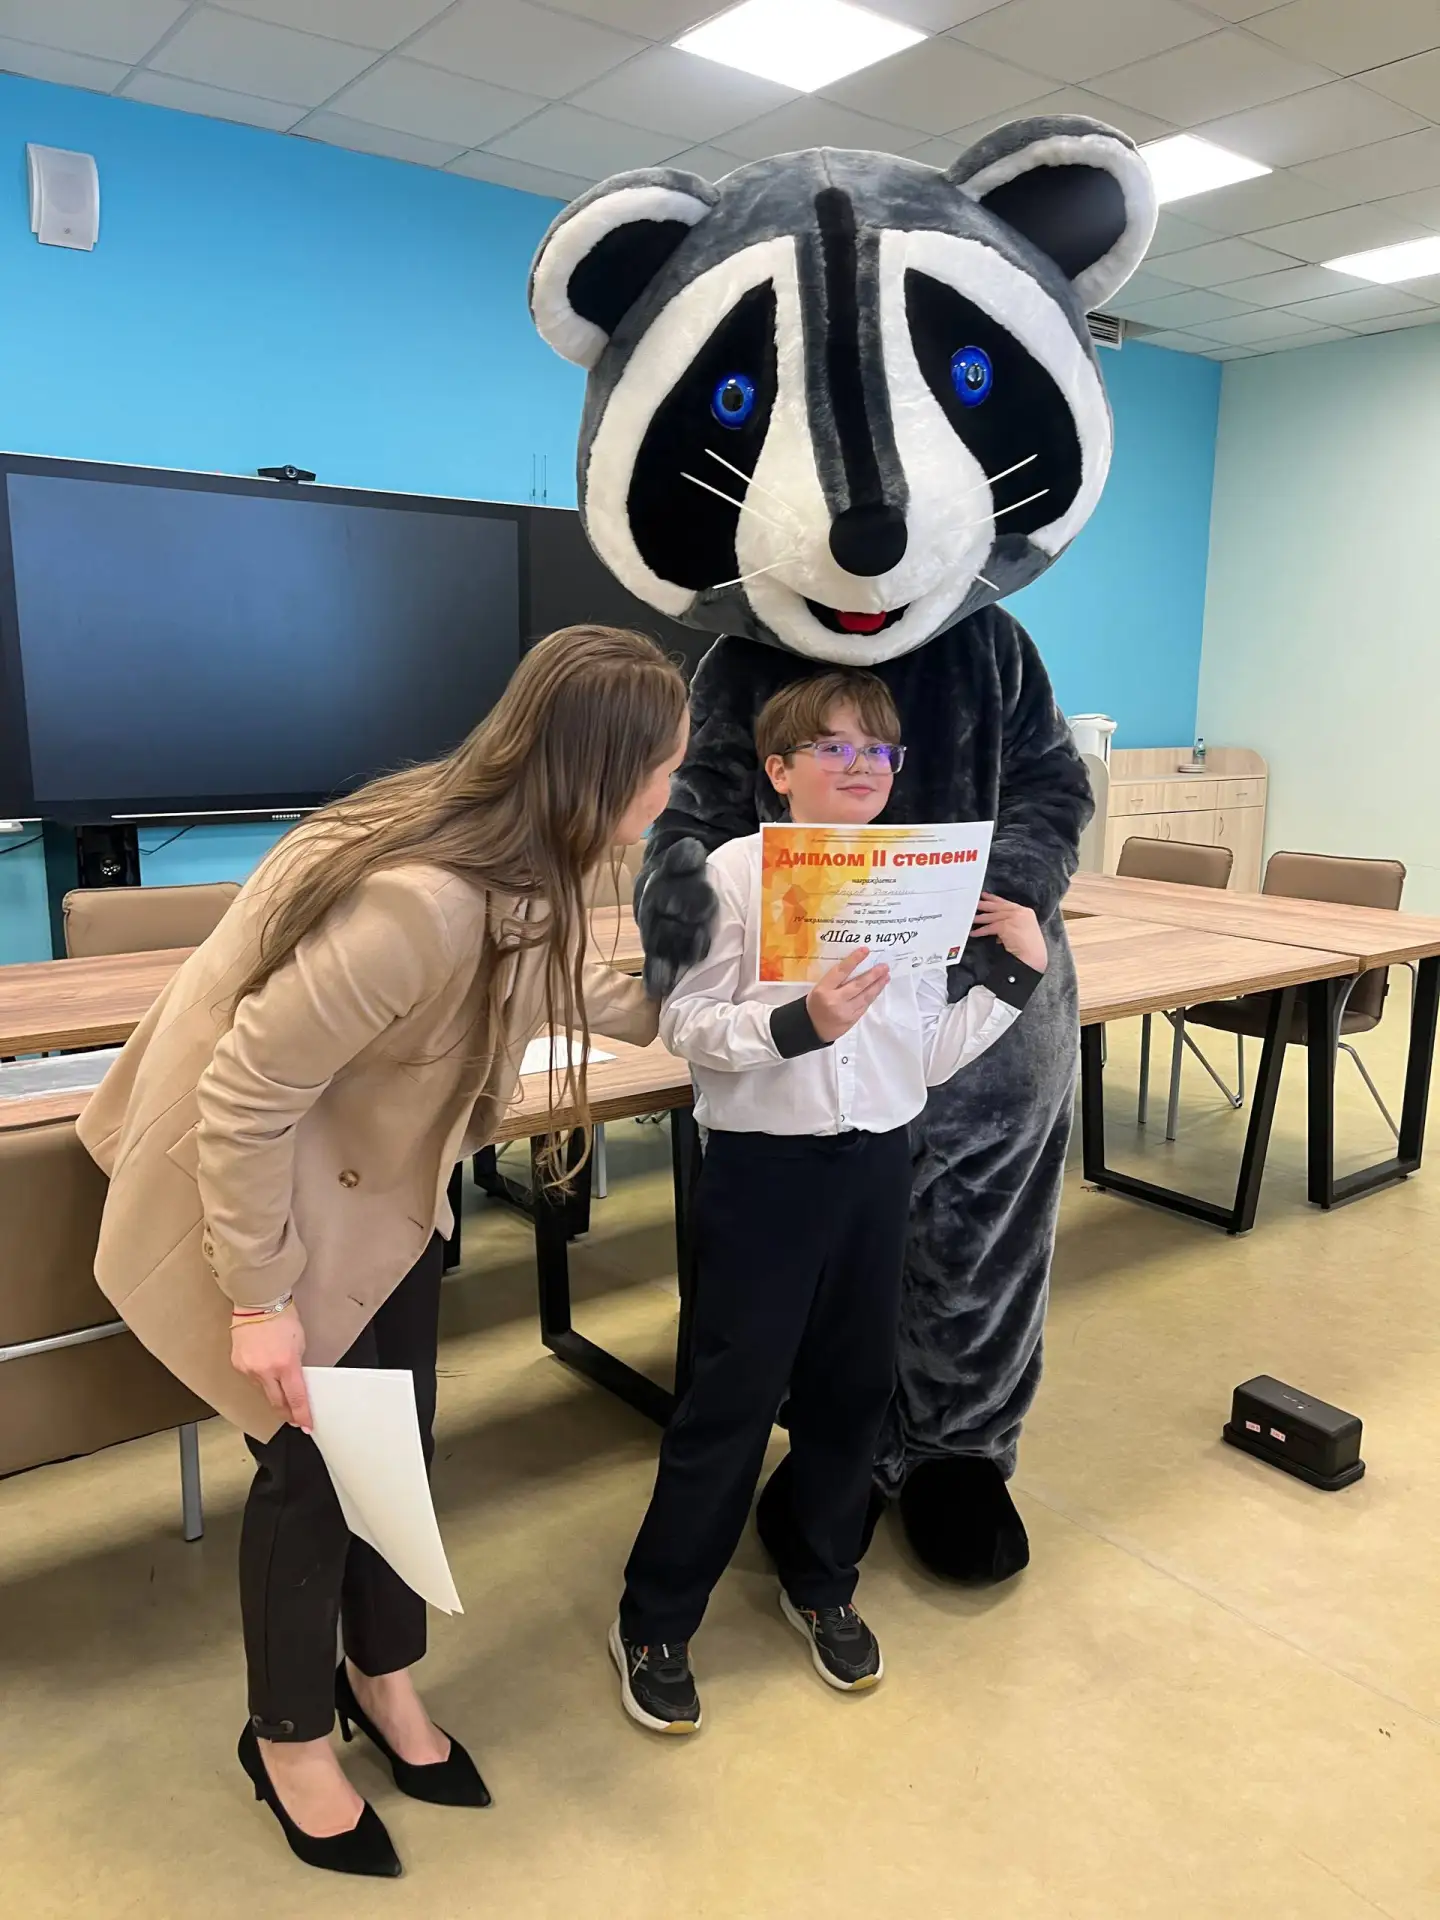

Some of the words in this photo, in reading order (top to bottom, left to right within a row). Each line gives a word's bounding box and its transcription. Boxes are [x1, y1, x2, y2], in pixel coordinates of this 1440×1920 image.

[775, 848, 864, 869] Диплом
[871, 849, 886, 867] II
[892, 849, 978, 867] степени
[851, 877, 897, 885] награждается
[865, 917, 907, 926] практической
[908, 913, 943, 924] конференции
[819, 929, 861, 943] «Шаг
[864, 933, 872, 943] в
[876, 931, 919, 946] науку»
